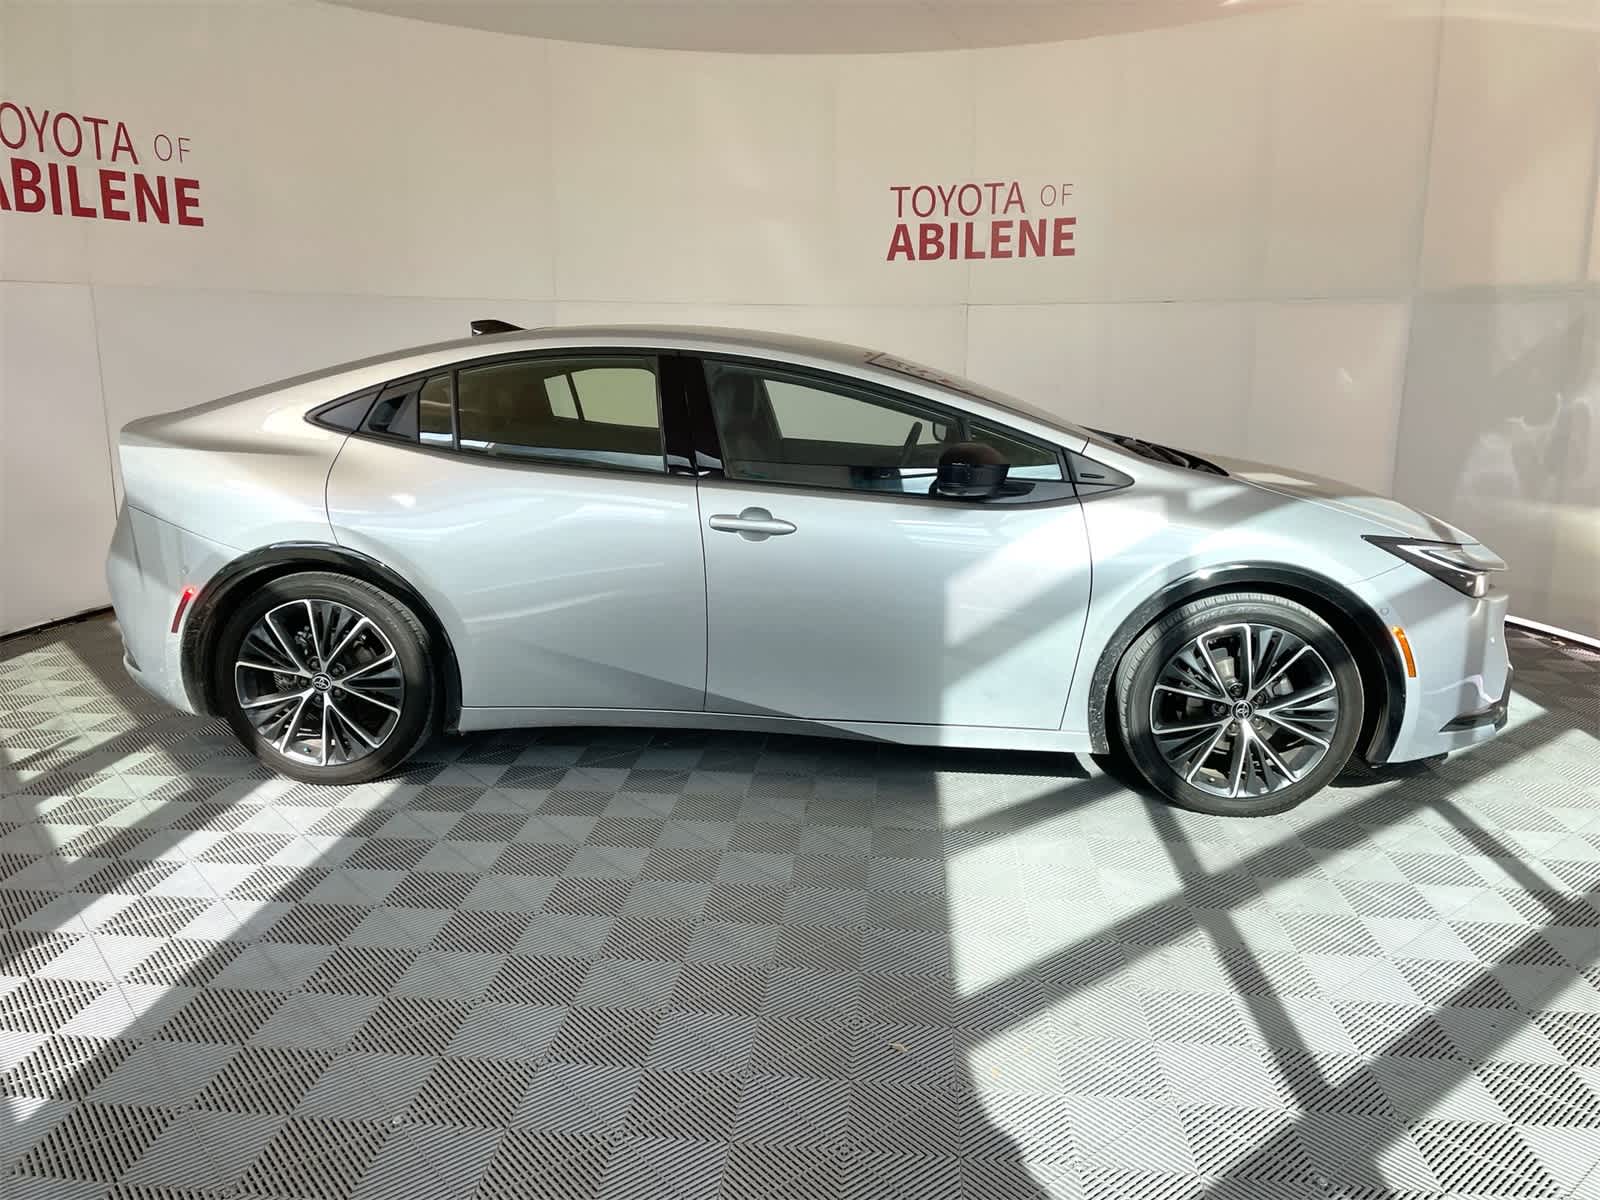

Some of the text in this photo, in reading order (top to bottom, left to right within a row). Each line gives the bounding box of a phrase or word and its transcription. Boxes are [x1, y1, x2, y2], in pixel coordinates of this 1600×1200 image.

[0, 102, 191, 165] OYOTA OF
[890, 181, 1074, 218] TOYOTA OF
[886, 217, 1077, 261] ABILENE
